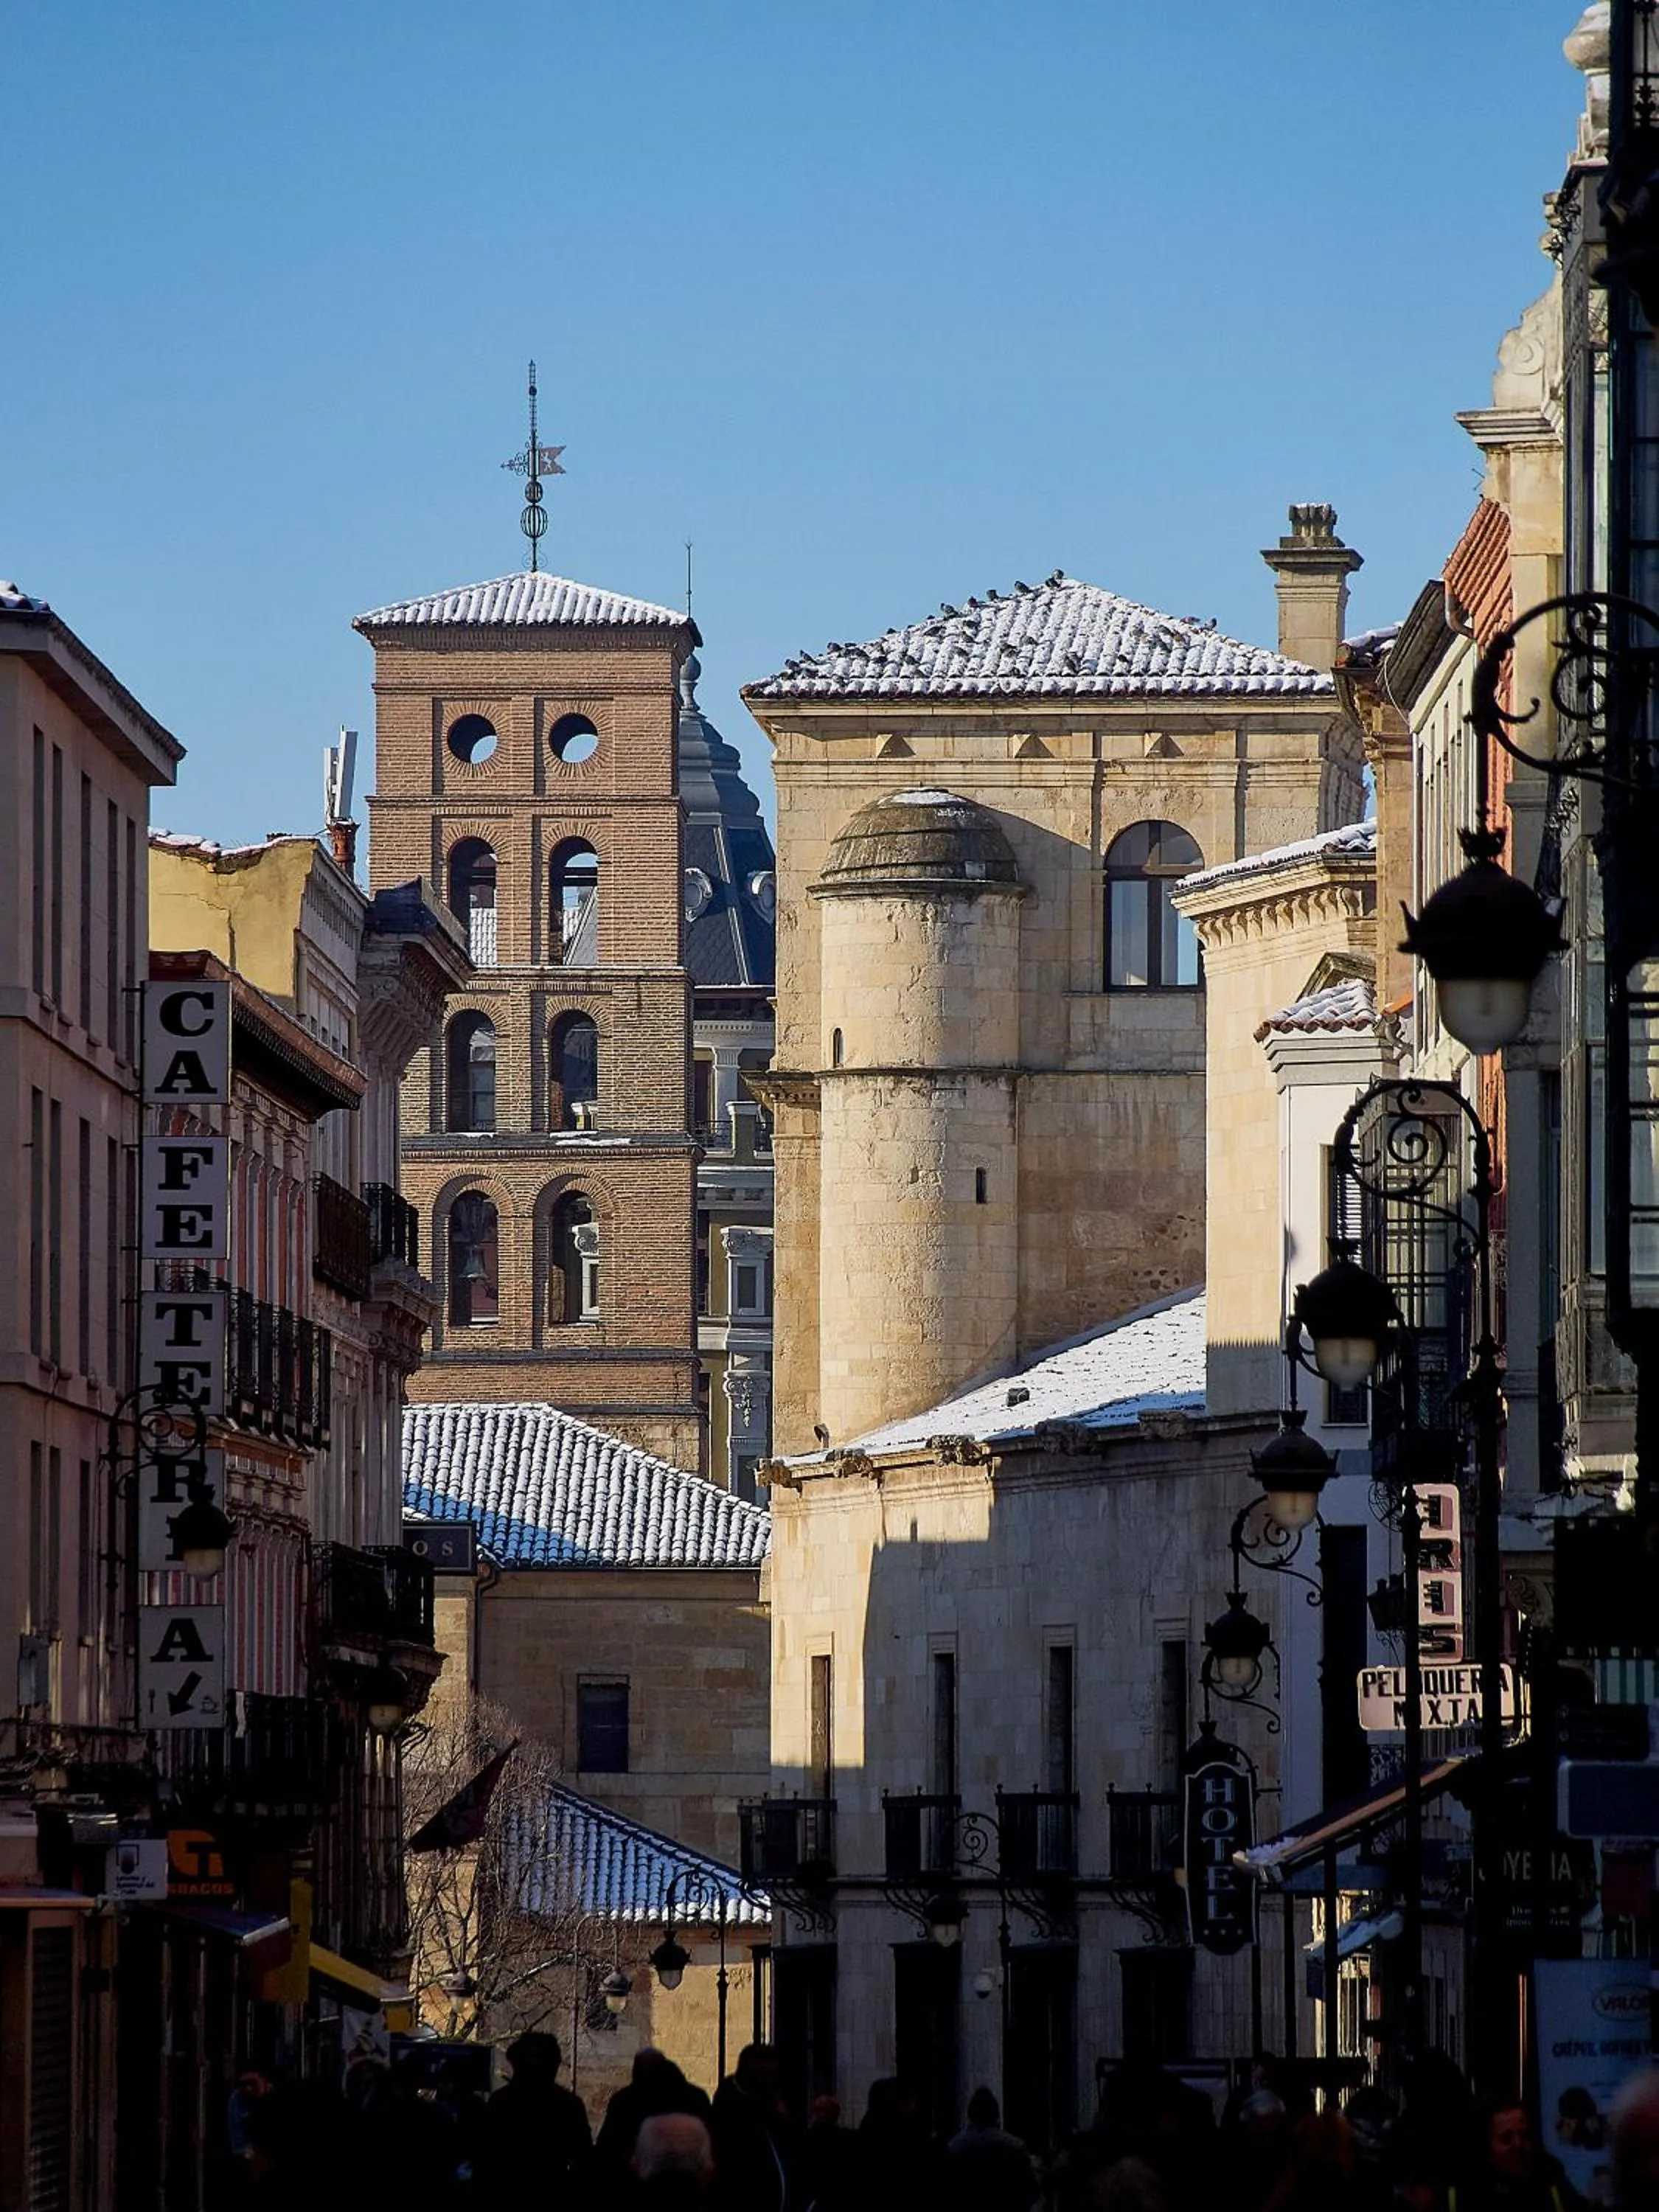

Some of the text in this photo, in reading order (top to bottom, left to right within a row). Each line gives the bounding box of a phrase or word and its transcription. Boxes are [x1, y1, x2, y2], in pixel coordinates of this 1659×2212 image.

[1362, 1668, 1509, 1698] PELQUERA
[1393, 1699, 1482, 1727] MXTA
[1201, 1778, 1237, 1920] HOTEL
[1478, 1849, 1573, 1882] YEIA
[167, 1882, 235, 1896] ABACOS
